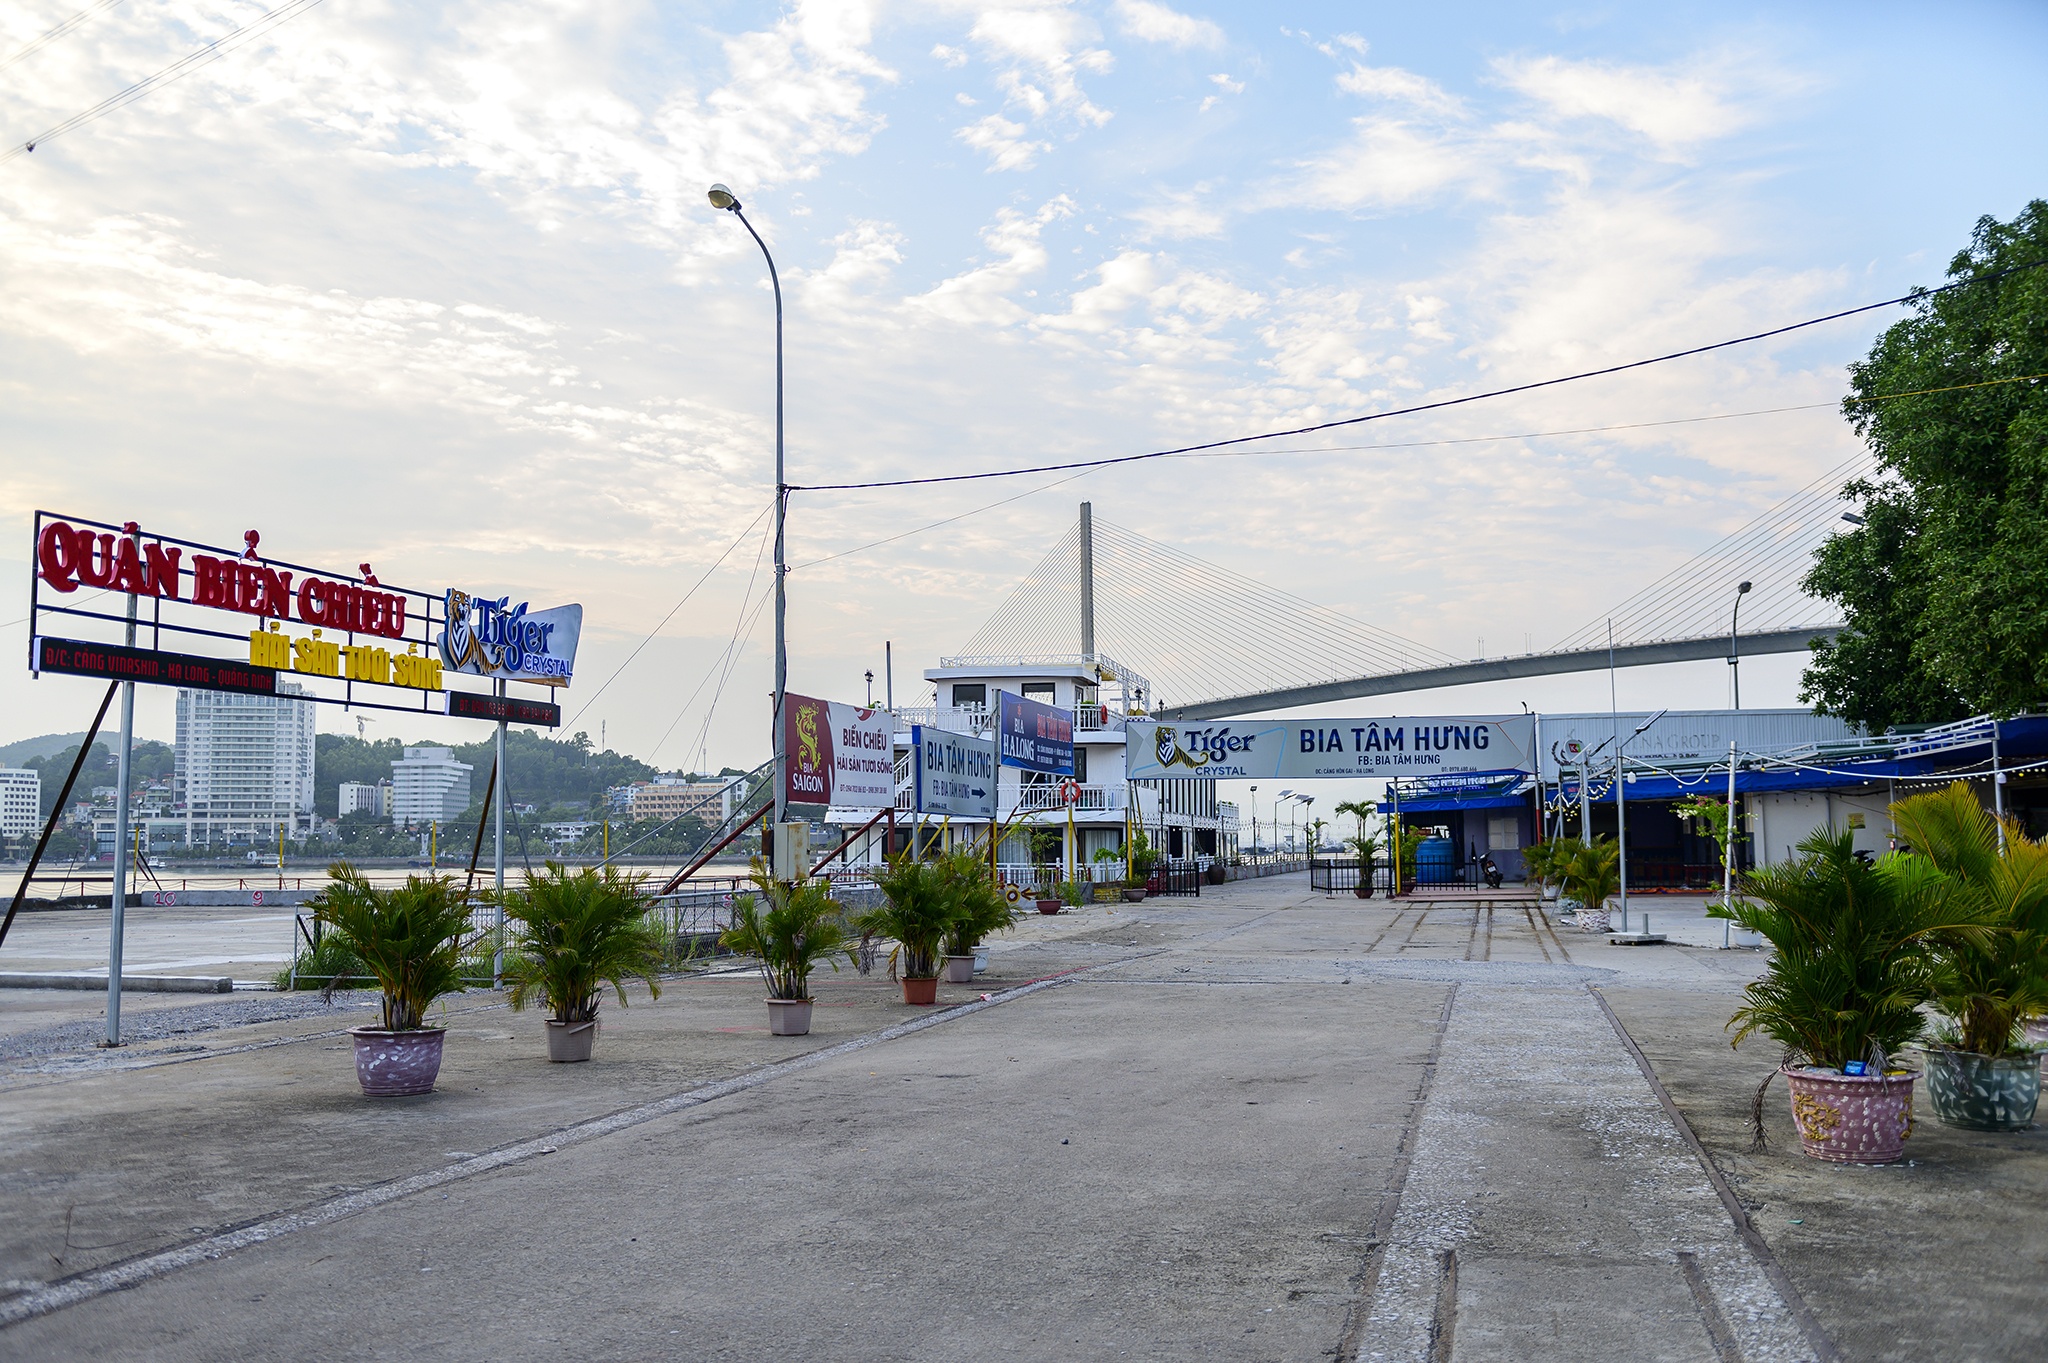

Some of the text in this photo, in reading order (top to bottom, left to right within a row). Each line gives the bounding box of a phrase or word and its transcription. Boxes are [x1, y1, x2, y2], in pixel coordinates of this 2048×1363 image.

[38, 521, 182, 600] QUÁN
[191, 529, 293, 620] BIỂN
[472, 596, 554, 672] Tiger
[249, 621, 442, 690] HẢI SẢN TƯƠI SỐNG
[523, 654, 573, 677] CRYSTAL
[45, 647, 71, 667] Đ/C:
[73, 648, 105, 671] CẢNG
[107, 655, 159, 676] VINASHIN
[167, 663, 182, 682] HẠ
[184, 665, 210, 683] LONG
[217, 667, 249, 687] QUẢNG
[251, 673, 273, 690] NINH
[842, 724, 862, 748] BIỂN
[1014, 717, 1025, 735] BIA
[1300, 721, 1489, 753] BIA TÂM HƯNG
[1184, 727, 1256, 763] Tiger
[1667, 734, 1720, 749] GROUP
[803, 762, 814, 774] BIA
[836, 752, 893, 775] HẢI SẢN TƯƠI SỐNG
[927, 739, 991, 780] BIA TÂM HƯNG
[1195, 766, 1247, 776] CRYSTAL
[1358, 753, 1440, 766] FB: BIA TÂM HƯNG
[793, 772, 824, 793] SAIGON
[153, 891, 177, 907] 10
[252, 890, 264, 907] 9
